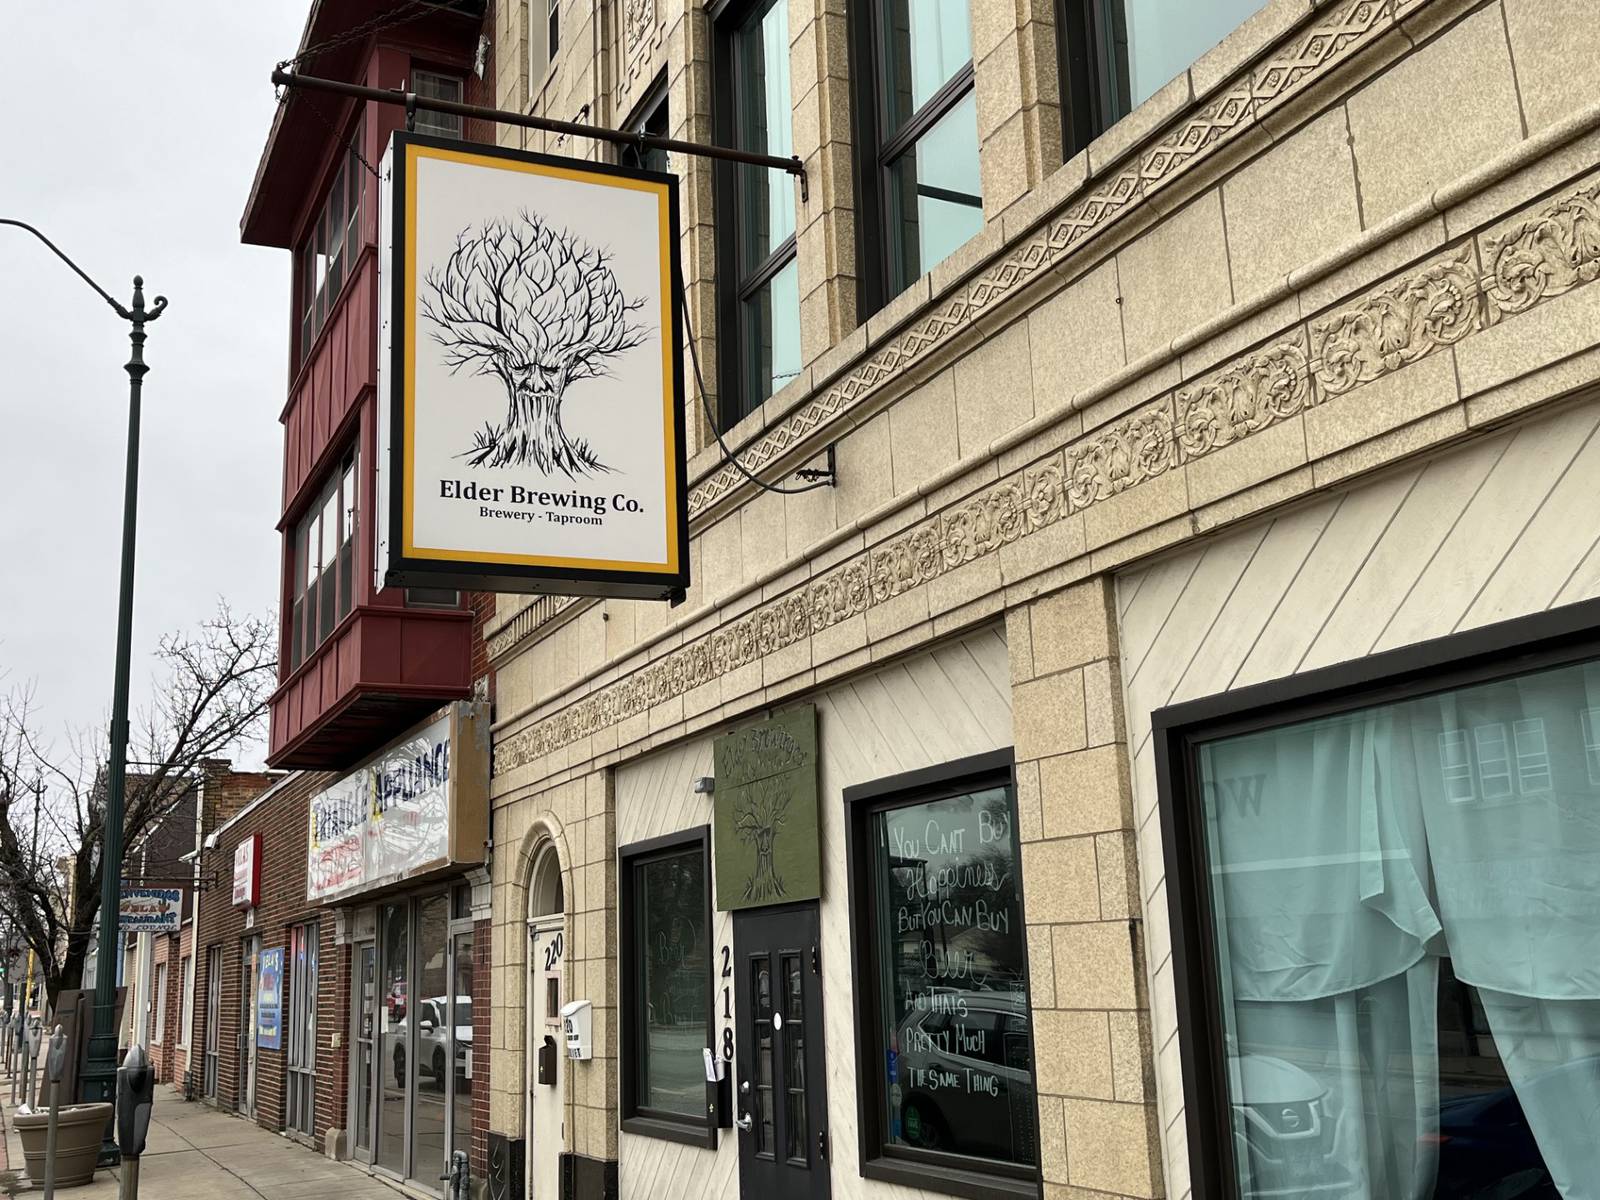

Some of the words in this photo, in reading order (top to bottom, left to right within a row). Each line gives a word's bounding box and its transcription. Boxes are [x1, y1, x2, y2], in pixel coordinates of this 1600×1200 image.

[439, 479, 504, 502] Elder
[510, 485, 606, 515] Brewing
[612, 493, 644, 513] Co.
[479, 506, 535, 523] Brewery
[545, 511, 603, 526] Taproom
[942, 900, 972, 927] CAN
[976, 899, 1009, 934] BUY
[544, 932, 563, 972] 220
[721, 945, 734, 1061] 218
[906, 1027, 950, 1055] PRETTY
[956, 1023, 985, 1054] MUCH
[907, 1066, 929, 1089] THE
[929, 1069, 960, 1090] SAME
[962, 1067, 999, 1097] THING
